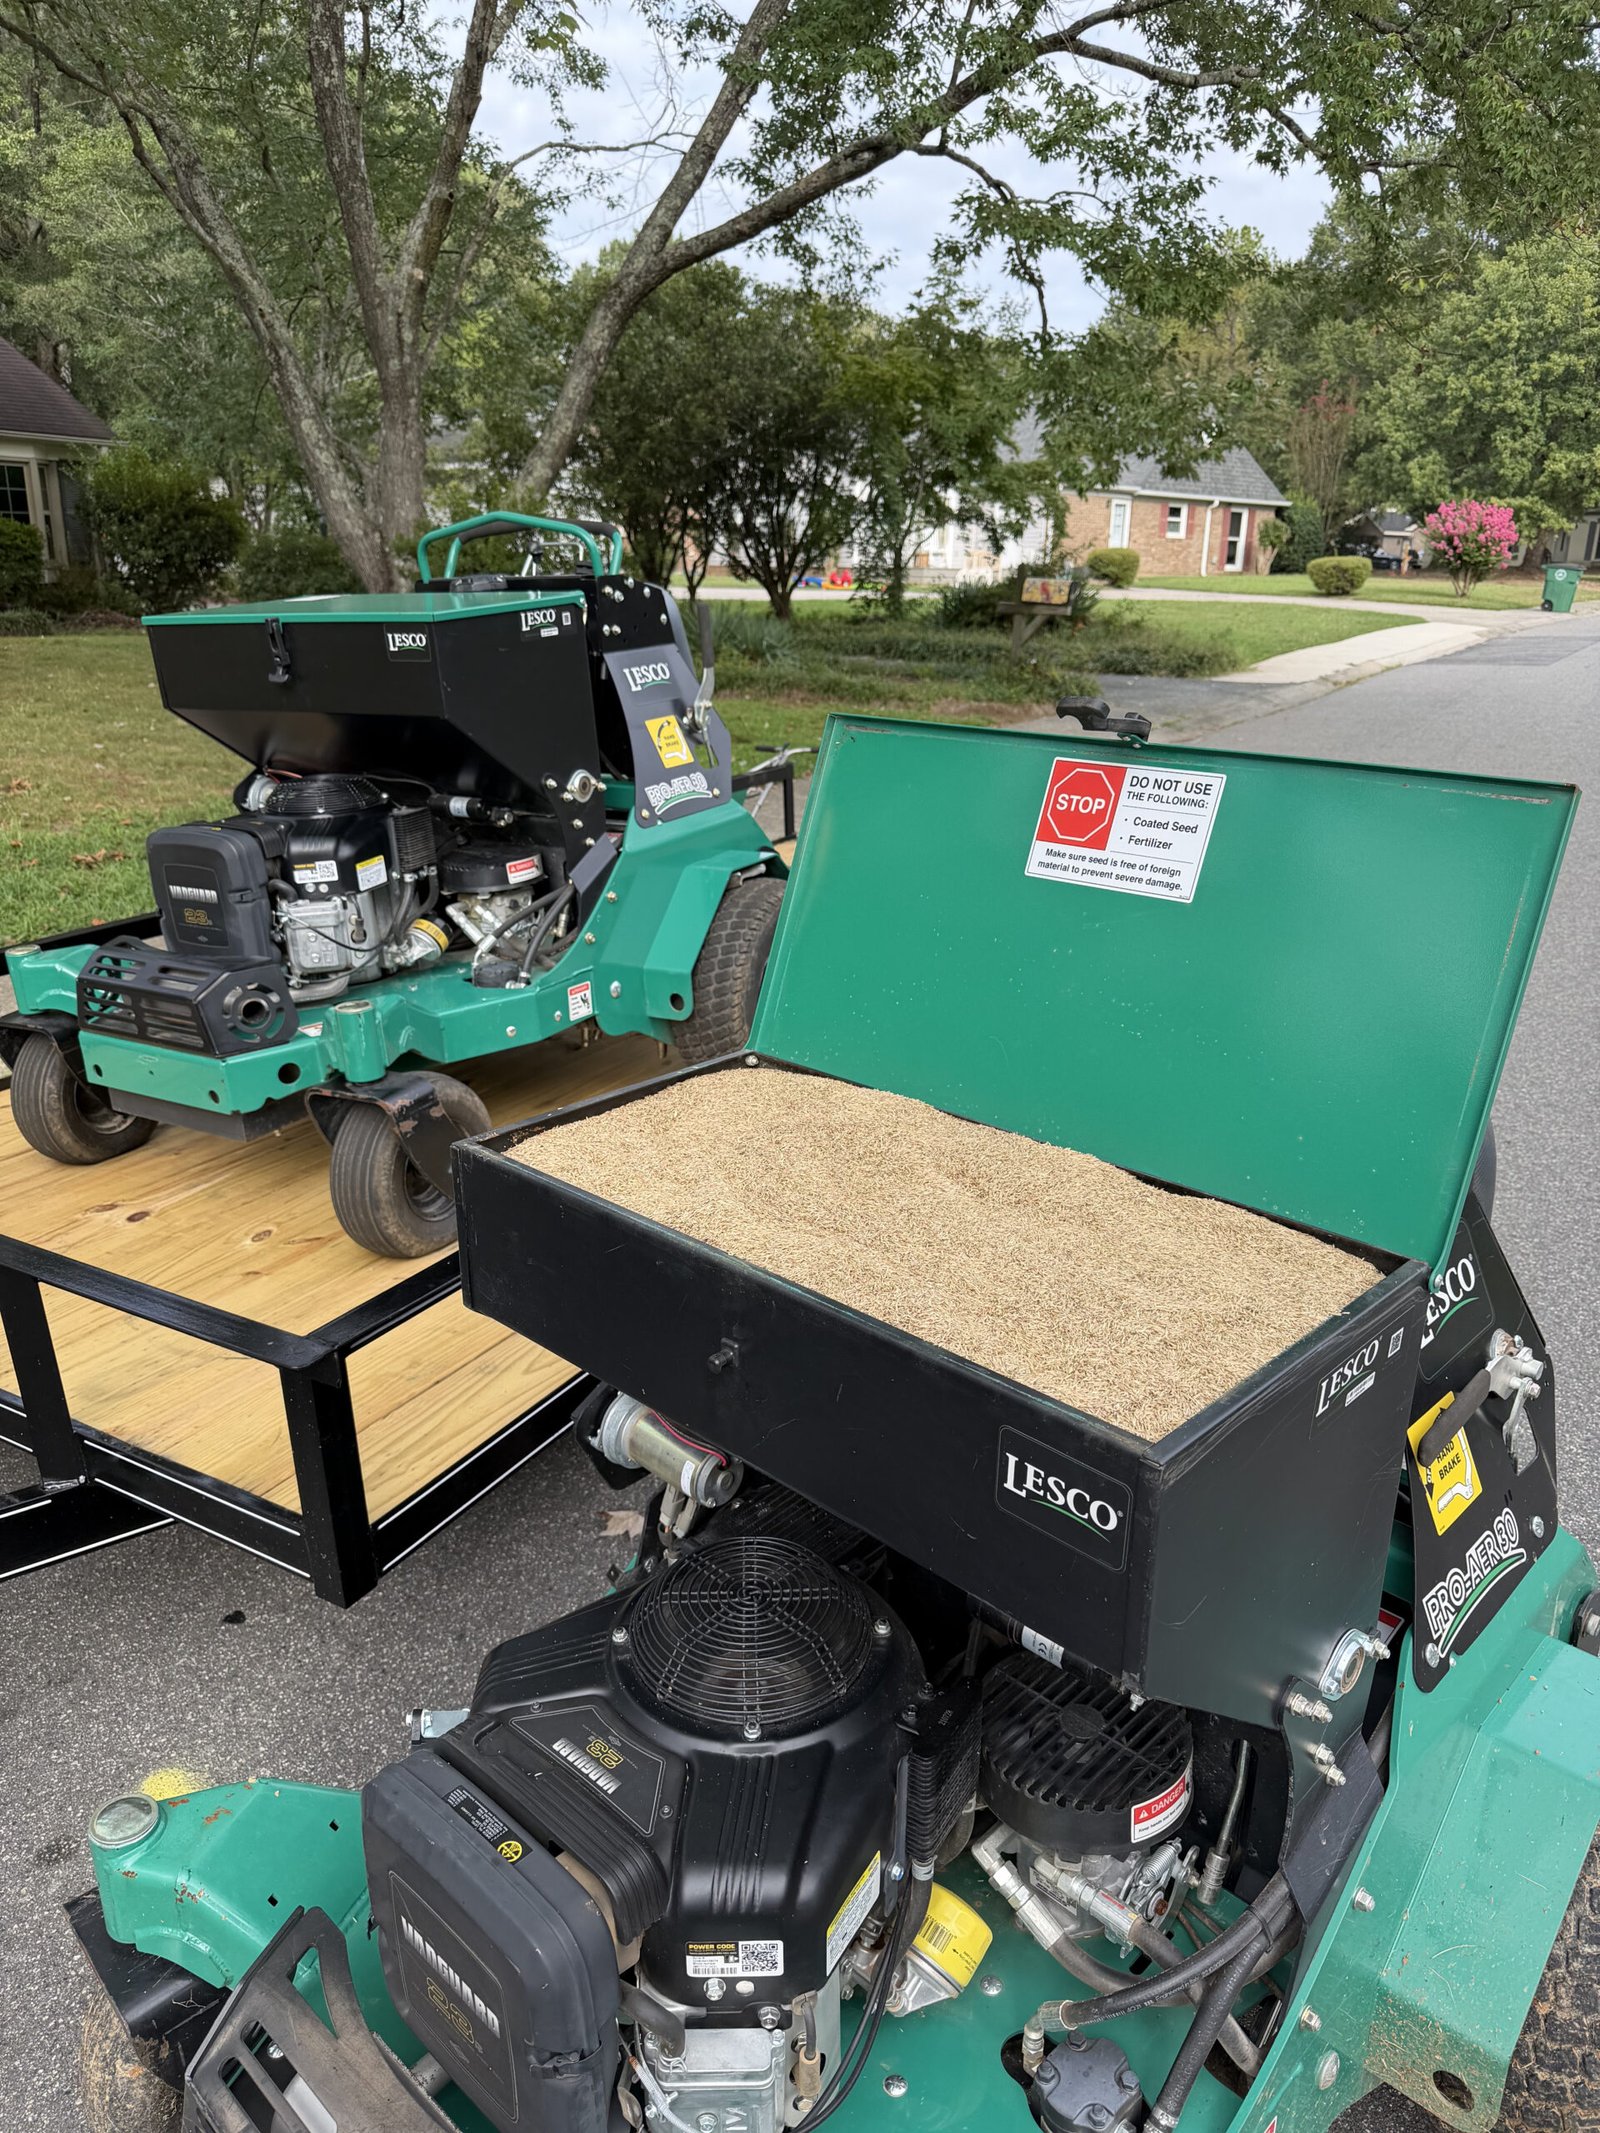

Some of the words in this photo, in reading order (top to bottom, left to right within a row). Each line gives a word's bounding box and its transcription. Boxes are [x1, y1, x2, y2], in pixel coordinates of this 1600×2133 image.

[520, 608, 556, 631] LESCO
[386, 633, 427, 651] LESCO
[623, 662, 671, 692] LESCO
[1127, 791, 1145, 801] THE
[1147, 793, 1209, 809] FOLLOWING:
[1130, 776, 1149, 789] DO
[1152, 778, 1180, 792] NOT
[1184, 782, 1213, 796] USE
[1056, 794, 1105, 815] STOP
[1133, 816, 1170, 831] Coated
[1171, 821, 1199, 834] Seed
[1128, 835, 1173, 851] Fertilizer
[1037, 860, 1070, 872] material
[1071, 865, 1080, 874] to
[1081, 867, 1113, 880] prevent
[1114, 872, 1143, 884] severe
[1145, 876, 1183, 891] damage.
[1045, 848, 1067, 859] Make
[1068, 853, 1086, 862] sure
[1088, 854, 1109, 865] seed
[1110, 857, 1118, 866] is
[1119, 858, 1137, 870] free
[1138, 862, 1149, 872] of
[1149, 863, 1181, 877] foreign
[169, 885, 218, 904] VANGUARD
[184, 908, 209, 925] 23
[1315, 1339, 1379, 1417] LESCO
[1438, 1453, 1462, 1480] BRAKE
[1003, 1452, 1118, 1531] LESCO
[1422, 1530, 1500, 1640] PRO-AER
[1493, 1507, 1519, 1554] 30
[552, 1737, 622, 1794] VANGUARD
[586, 1739, 624, 1769] 23
[1151, 1783, 1184, 1814] DANGER
[400, 1914, 501, 2039] VANGUARD
[426, 1976, 474, 2044] 23
